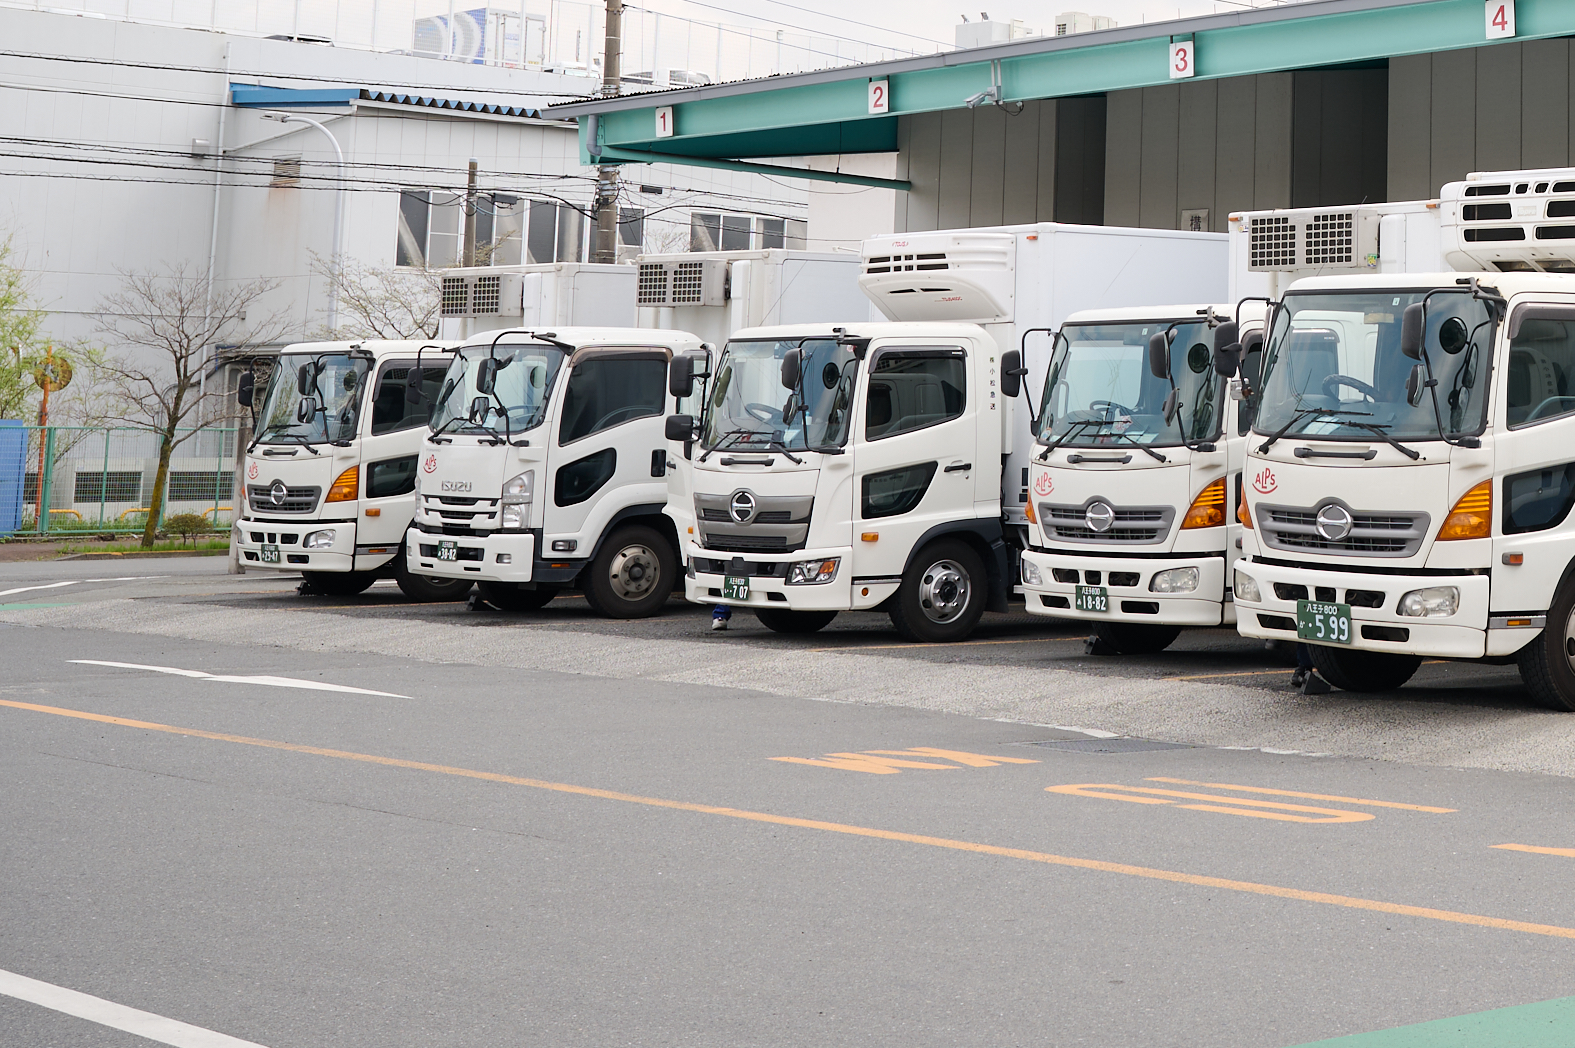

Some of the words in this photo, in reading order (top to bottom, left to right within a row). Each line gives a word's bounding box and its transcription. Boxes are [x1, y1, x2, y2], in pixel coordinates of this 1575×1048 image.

[1491, 4, 1507, 31] 4
[1174, 47, 1188, 72] 3
[872, 85, 885, 111] 2
[660, 112, 667, 132] 1
[425, 454, 437, 470] ALPS
[441, 480, 473, 492] ISUZU
[1036, 471, 1053, 492] ALPS
[1255, 467, 1276, 489] ALPS
[1082, 594, 1107, 611] 18-82
[1306, 602, 1338, 615] 八王子800
